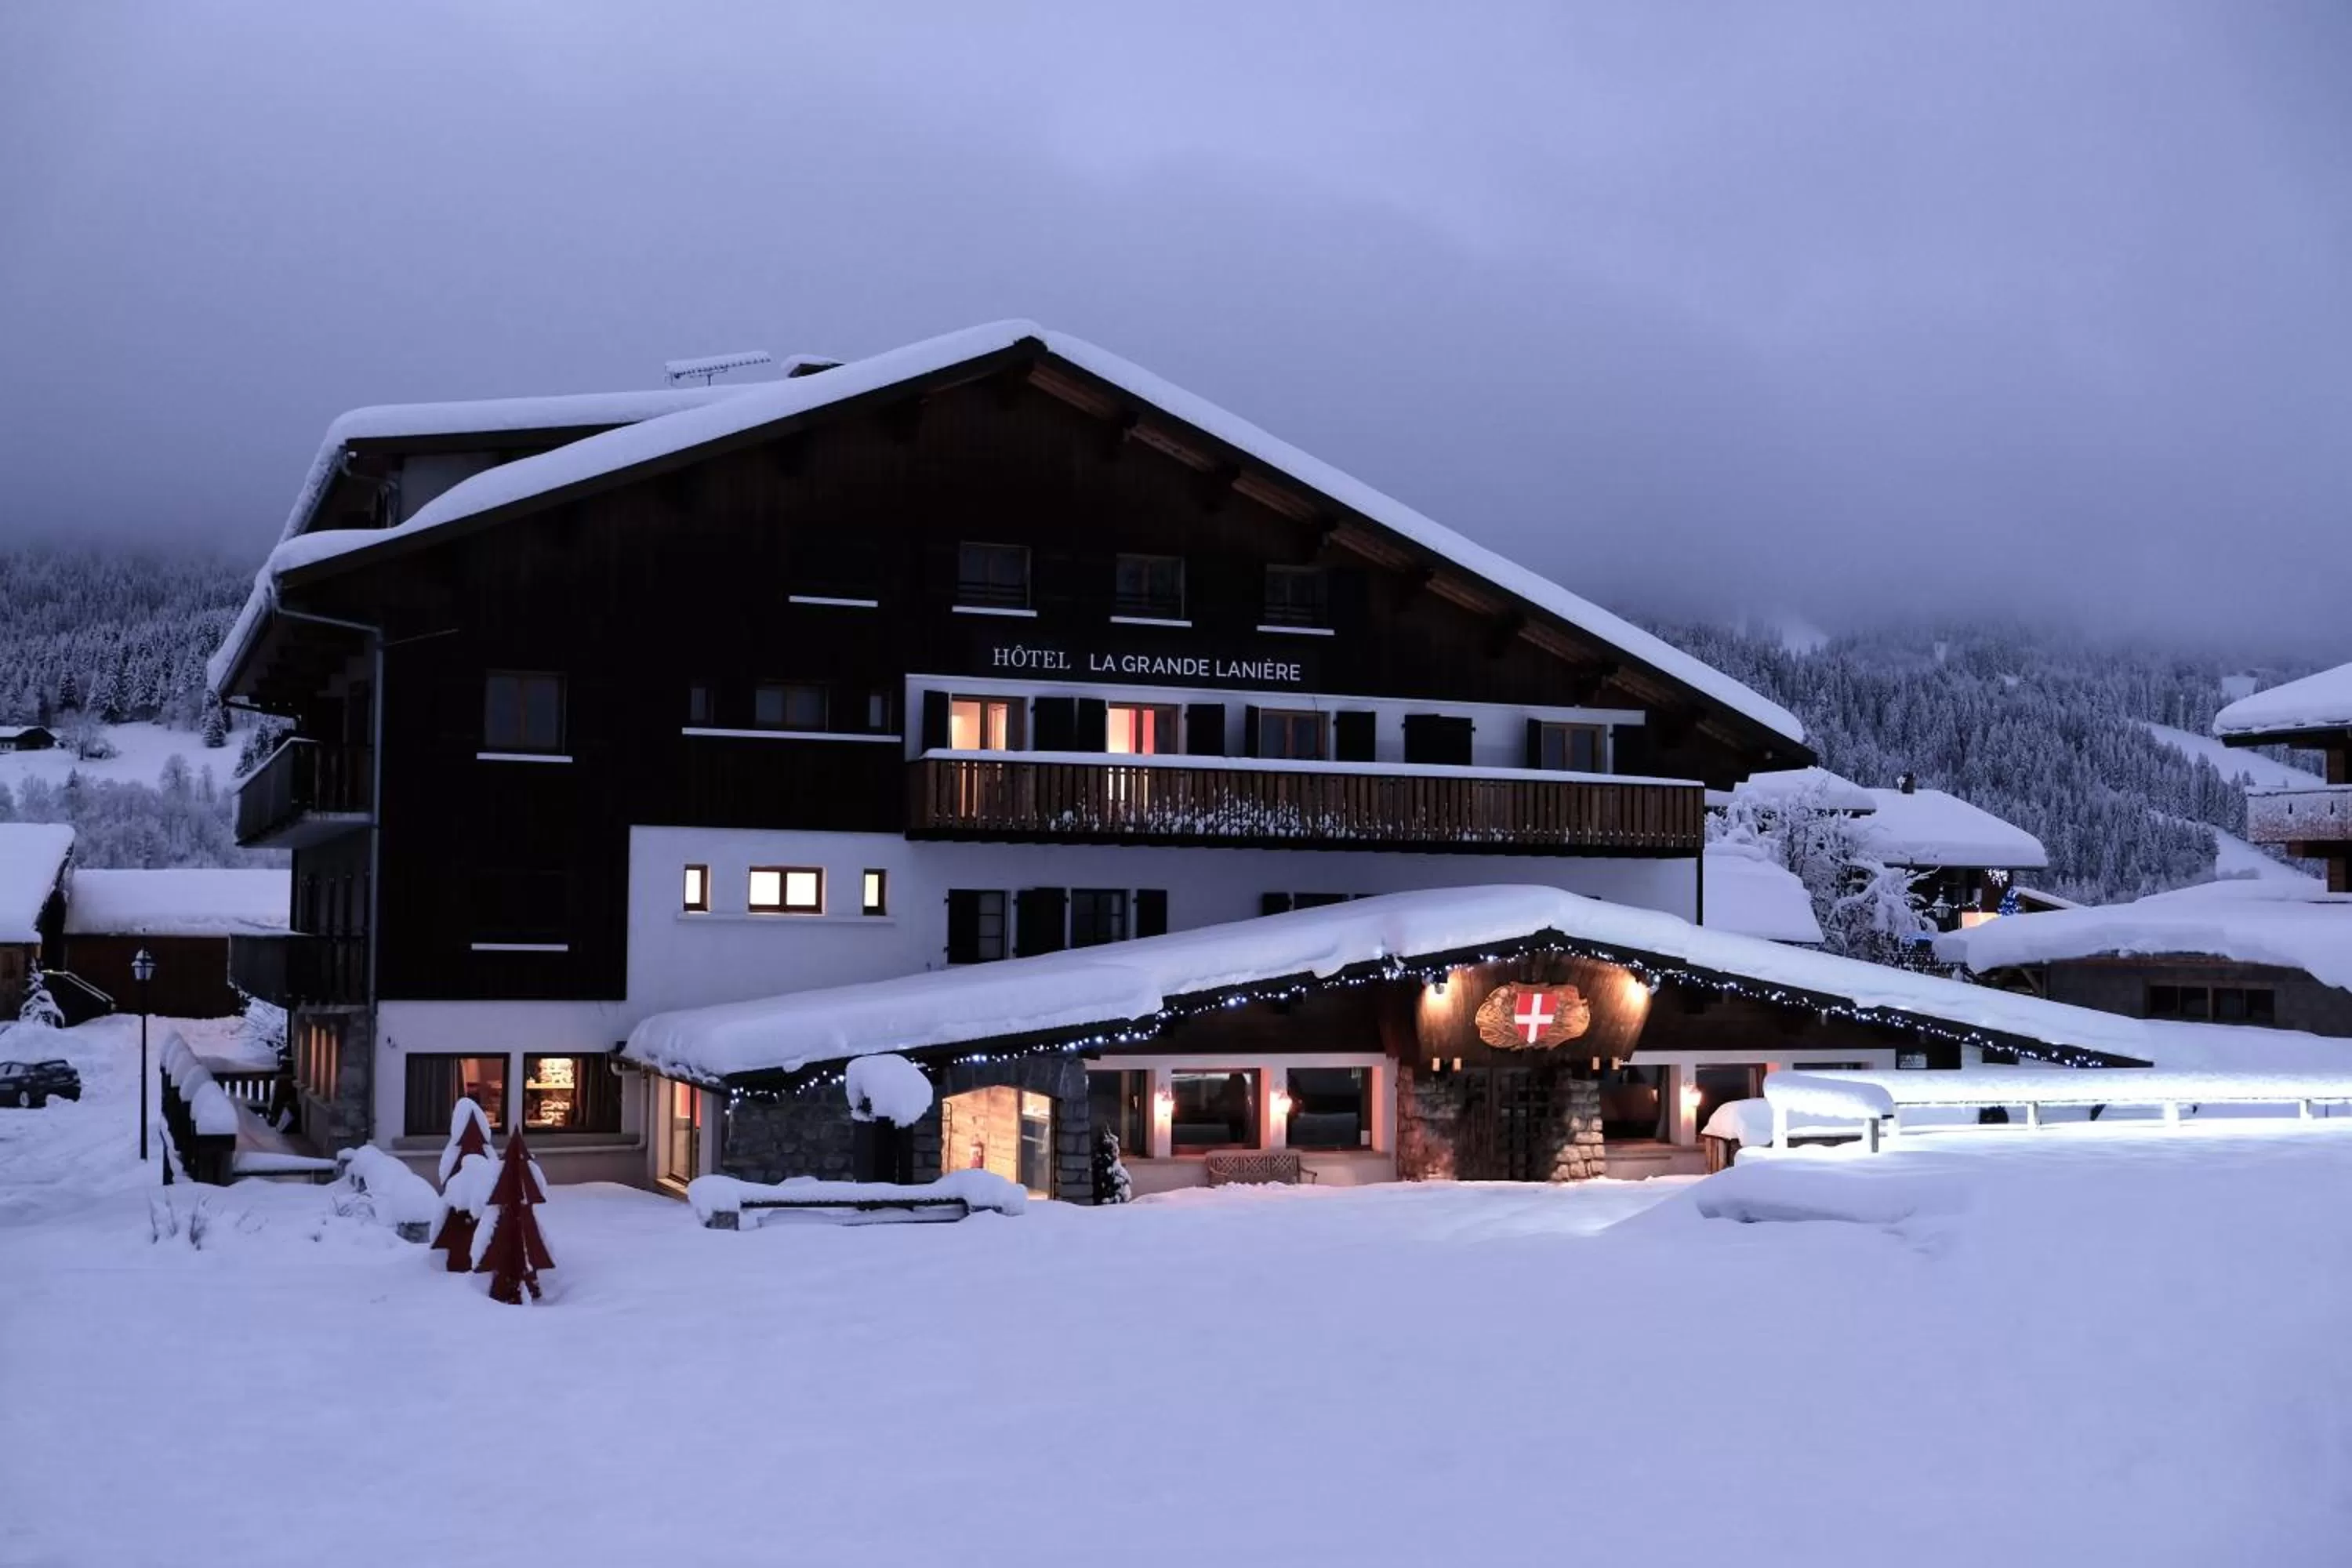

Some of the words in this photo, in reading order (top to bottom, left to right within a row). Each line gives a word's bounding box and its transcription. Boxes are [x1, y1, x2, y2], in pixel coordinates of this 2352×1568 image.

[993, 644, 1070, 670] HÔTEL
[1090, 653, 1116, 672] LA
[1121, 655, 1210, 677] GRANDE
[1216, 658, 1301, 681] LANIÈRE
